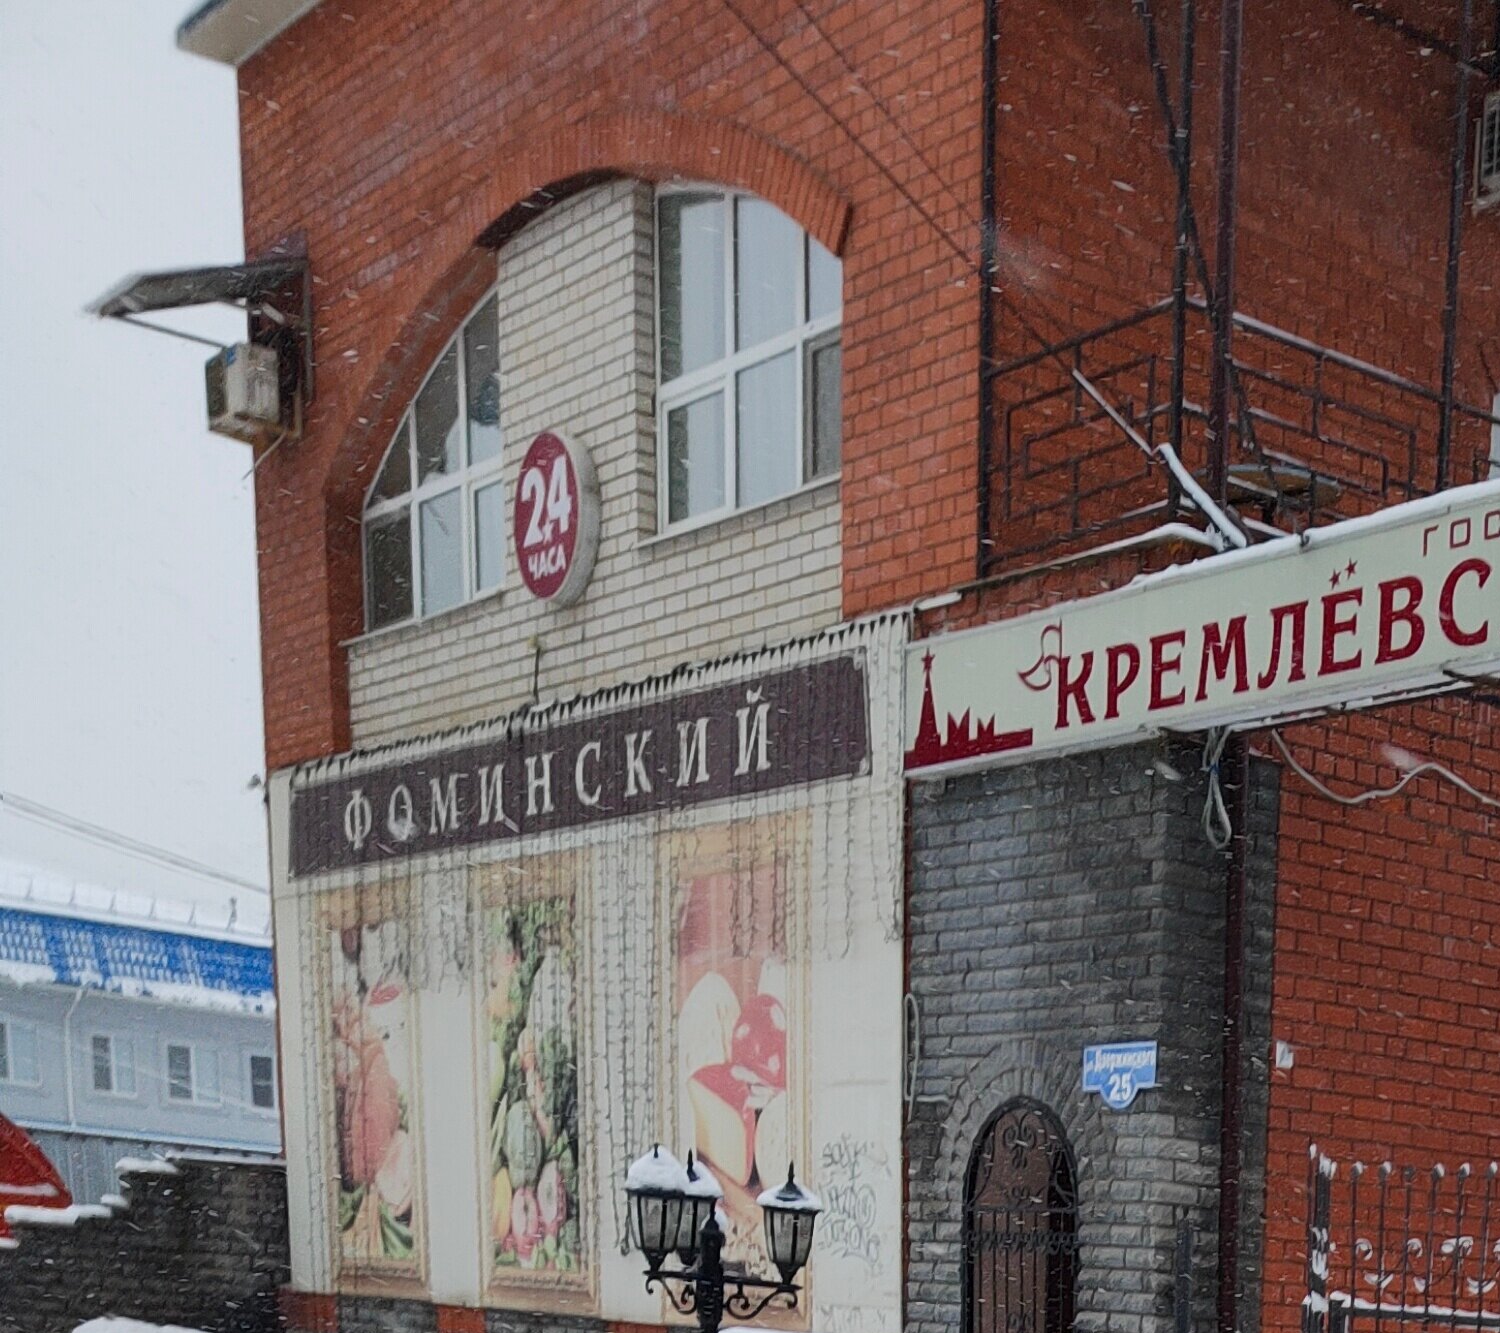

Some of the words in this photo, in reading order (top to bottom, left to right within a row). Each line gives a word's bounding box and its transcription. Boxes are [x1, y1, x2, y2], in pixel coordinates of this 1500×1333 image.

[521, 454, 573, 548] 24
[527, 542, 567, 581] ЧАСА
[343, 685, 772, 851] ФОМИНСКИЙ
[1108, 1068, 1134, 1101] 25
